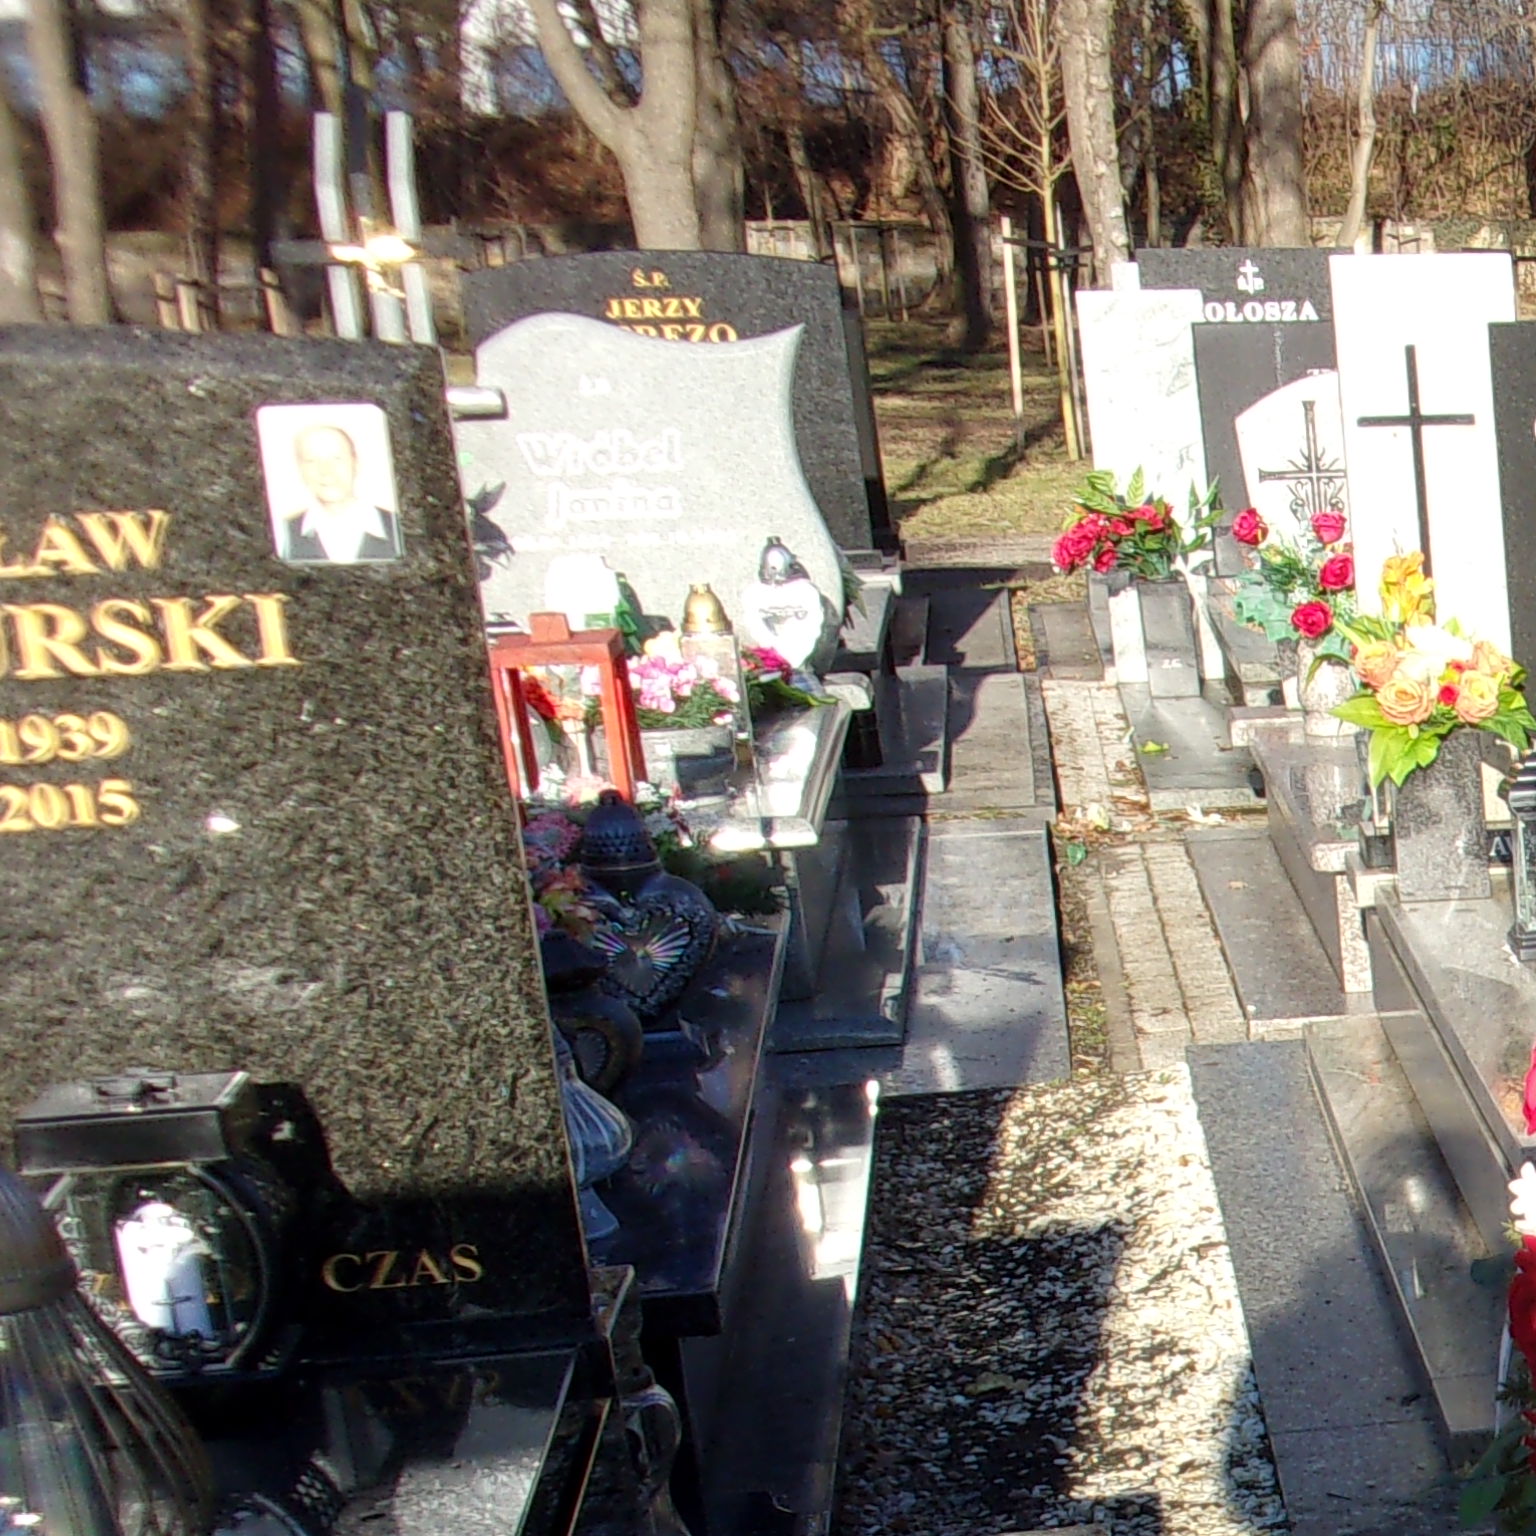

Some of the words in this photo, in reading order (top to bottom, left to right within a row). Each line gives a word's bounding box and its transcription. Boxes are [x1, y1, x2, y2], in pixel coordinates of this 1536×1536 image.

[605, 297, 704, 320] JERZY
[1201, 299, 1320, 323] OŁOSZA
[322, 1243, 484, 1293] CZAS
